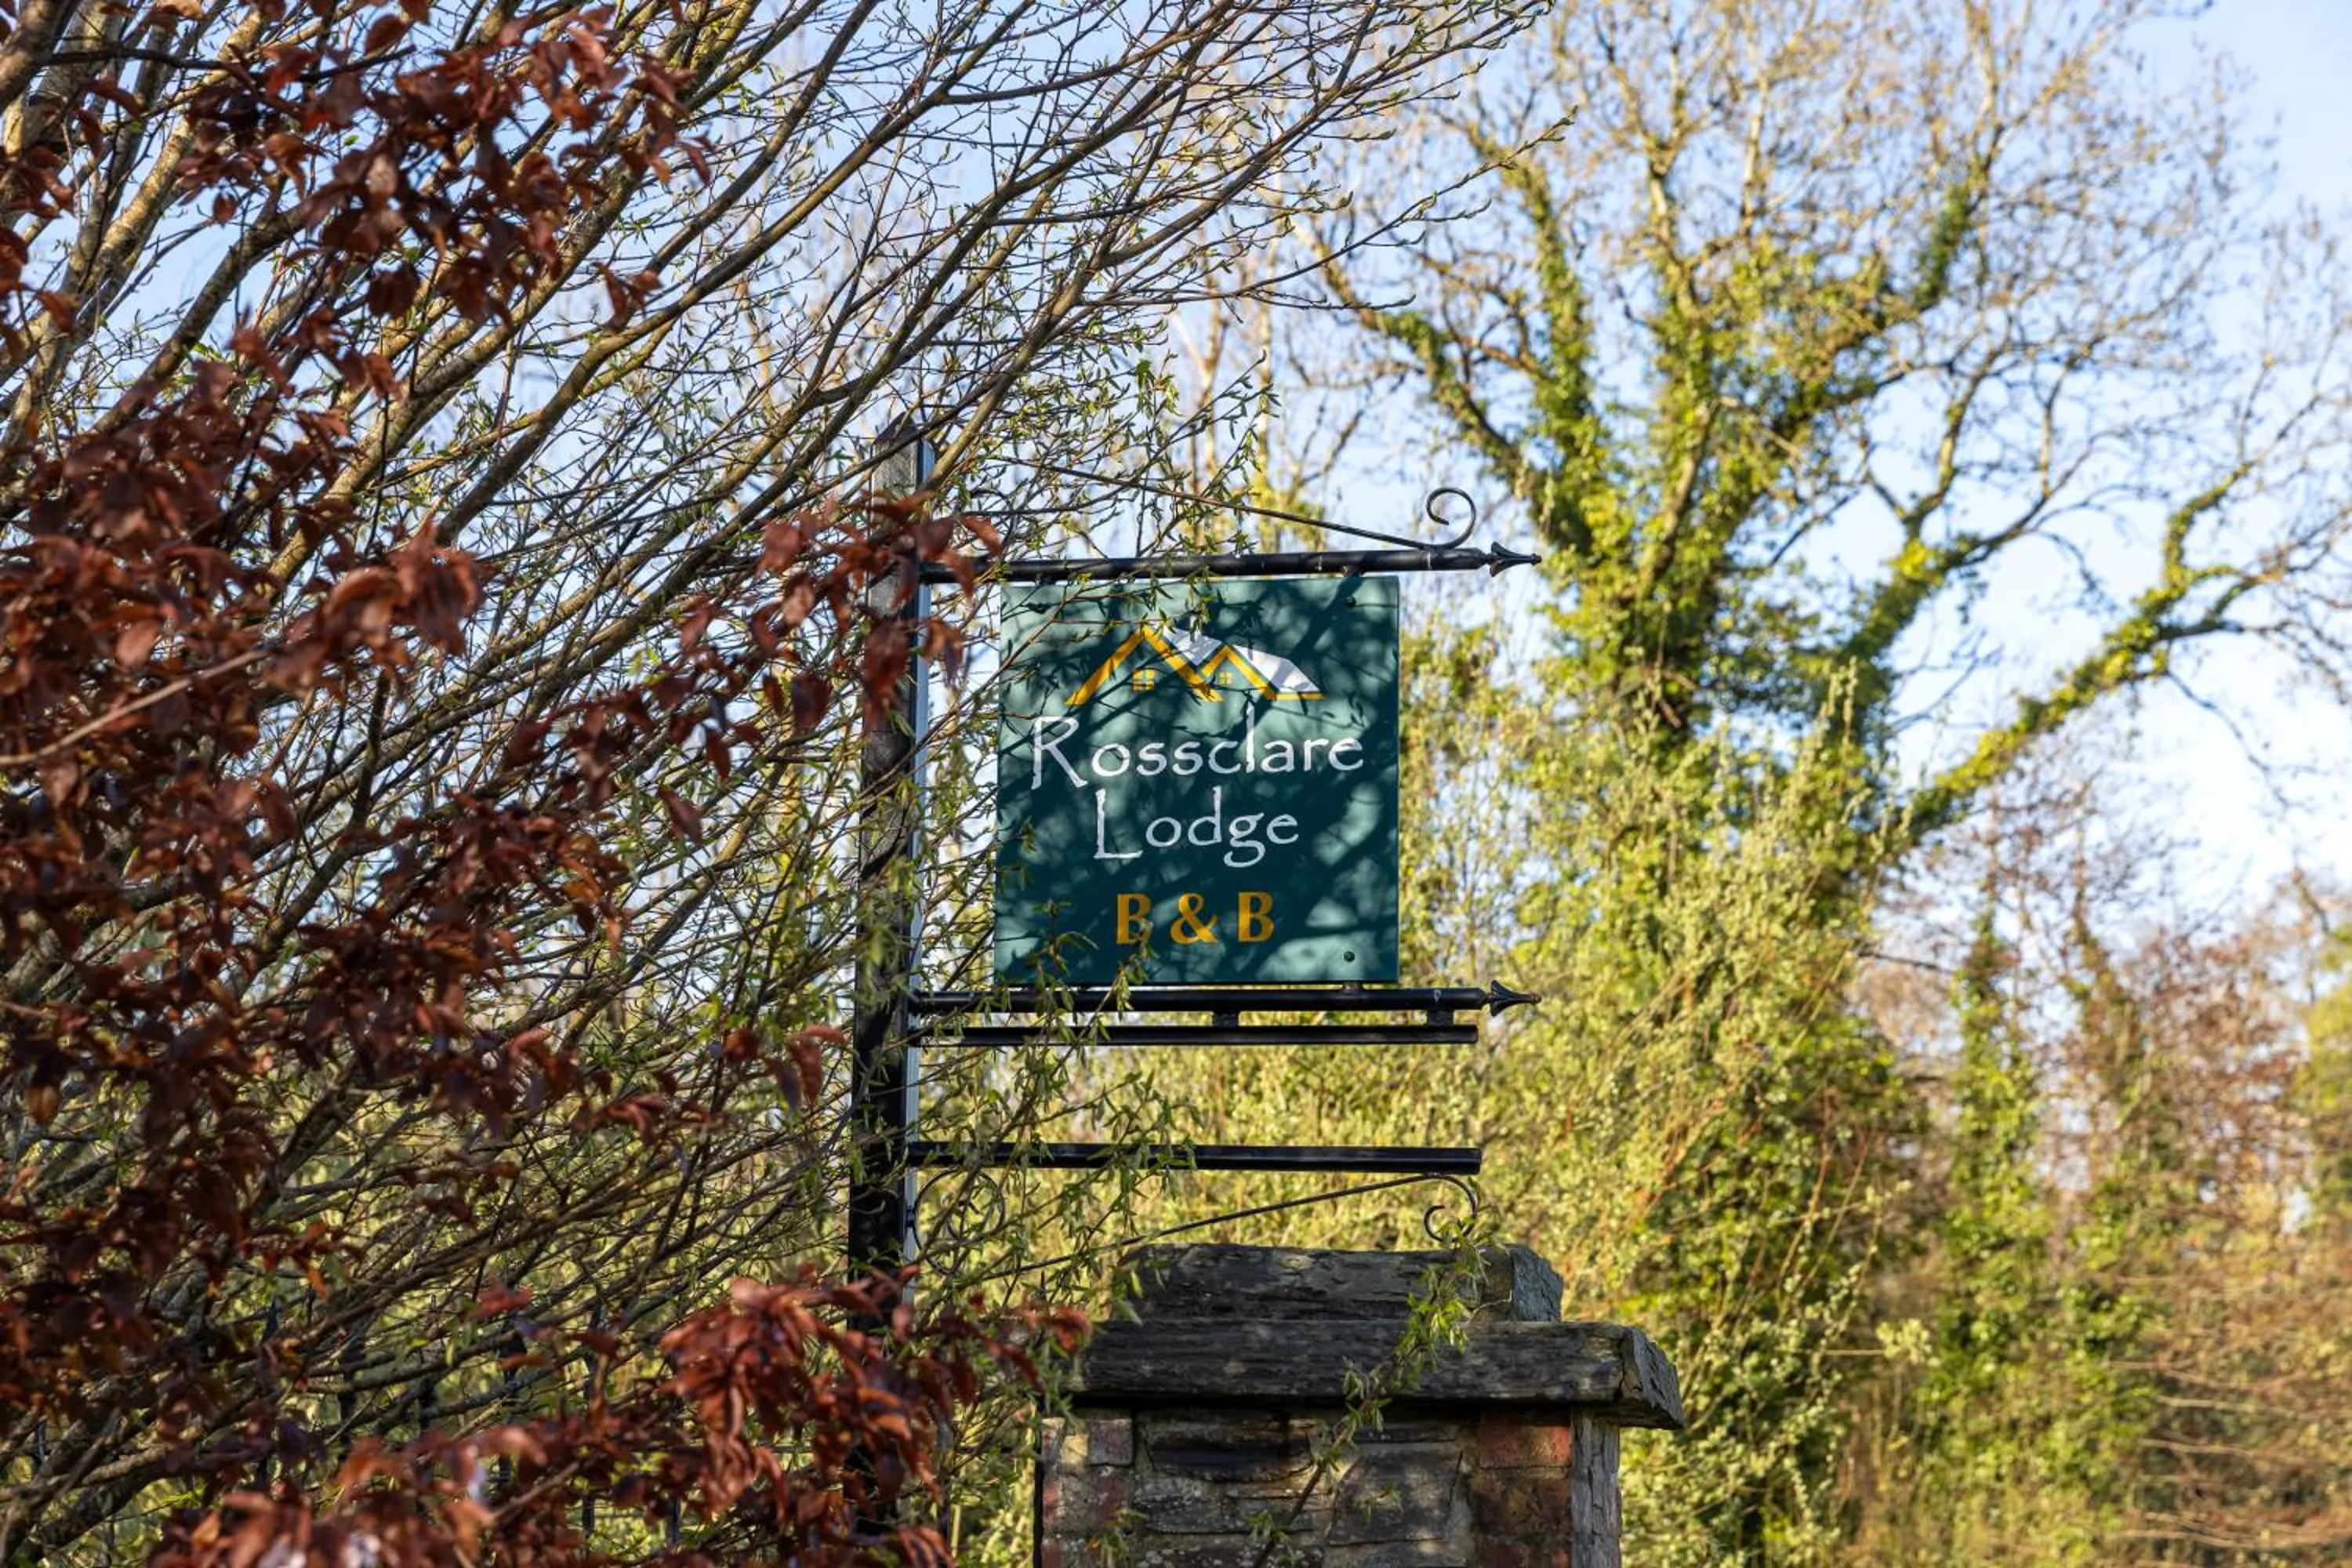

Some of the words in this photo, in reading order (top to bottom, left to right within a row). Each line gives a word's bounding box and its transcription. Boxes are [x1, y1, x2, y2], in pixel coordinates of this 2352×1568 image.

[1031, 705, 1364, 790] Rossclare
[1093, 786, 1300, 868] Lodge
[1116, 892, 1152, 945] B
[1170, 891, 1218, 945] &
[1237, 891, 1276, 943] B
